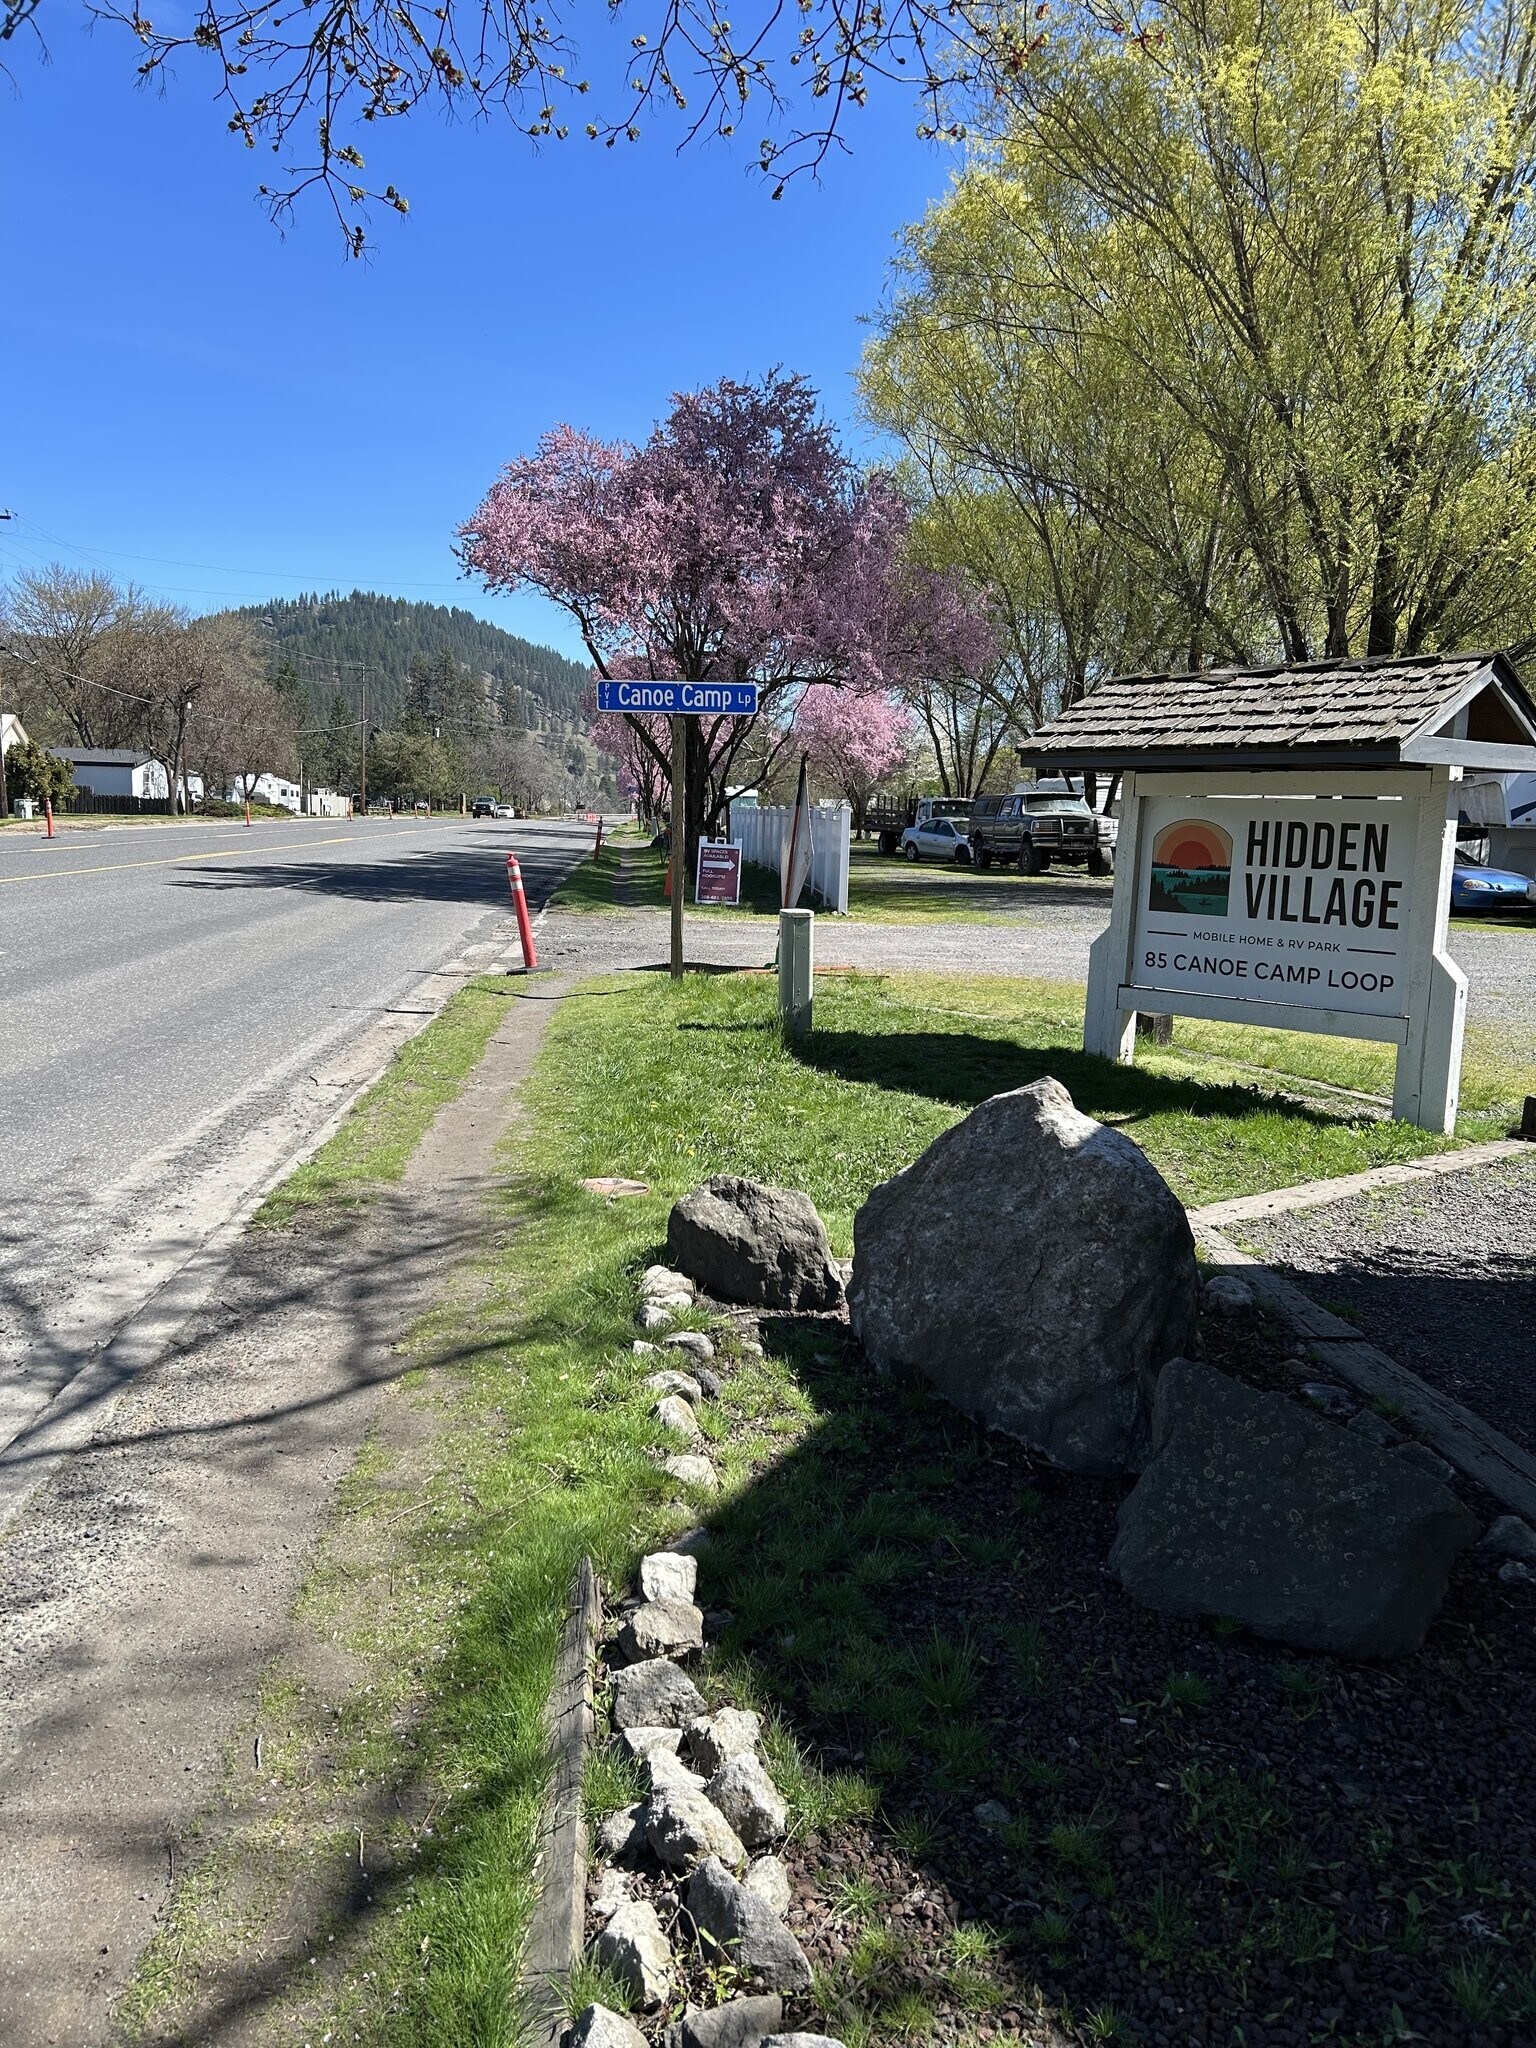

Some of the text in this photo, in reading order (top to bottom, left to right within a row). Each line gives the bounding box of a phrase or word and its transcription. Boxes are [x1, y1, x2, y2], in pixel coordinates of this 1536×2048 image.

[618, 683, 751, 711] Canoe Camp Lp
[1246, 820, 1389, 873] HIDDEN
[1245, 873, 1403, 930] VILLAGE
[1193, 931, 1341, 953] MOBILE HOME & RV PARK
[1145, 951, 1394, 993] 85 CANOE CAMP LOOP
